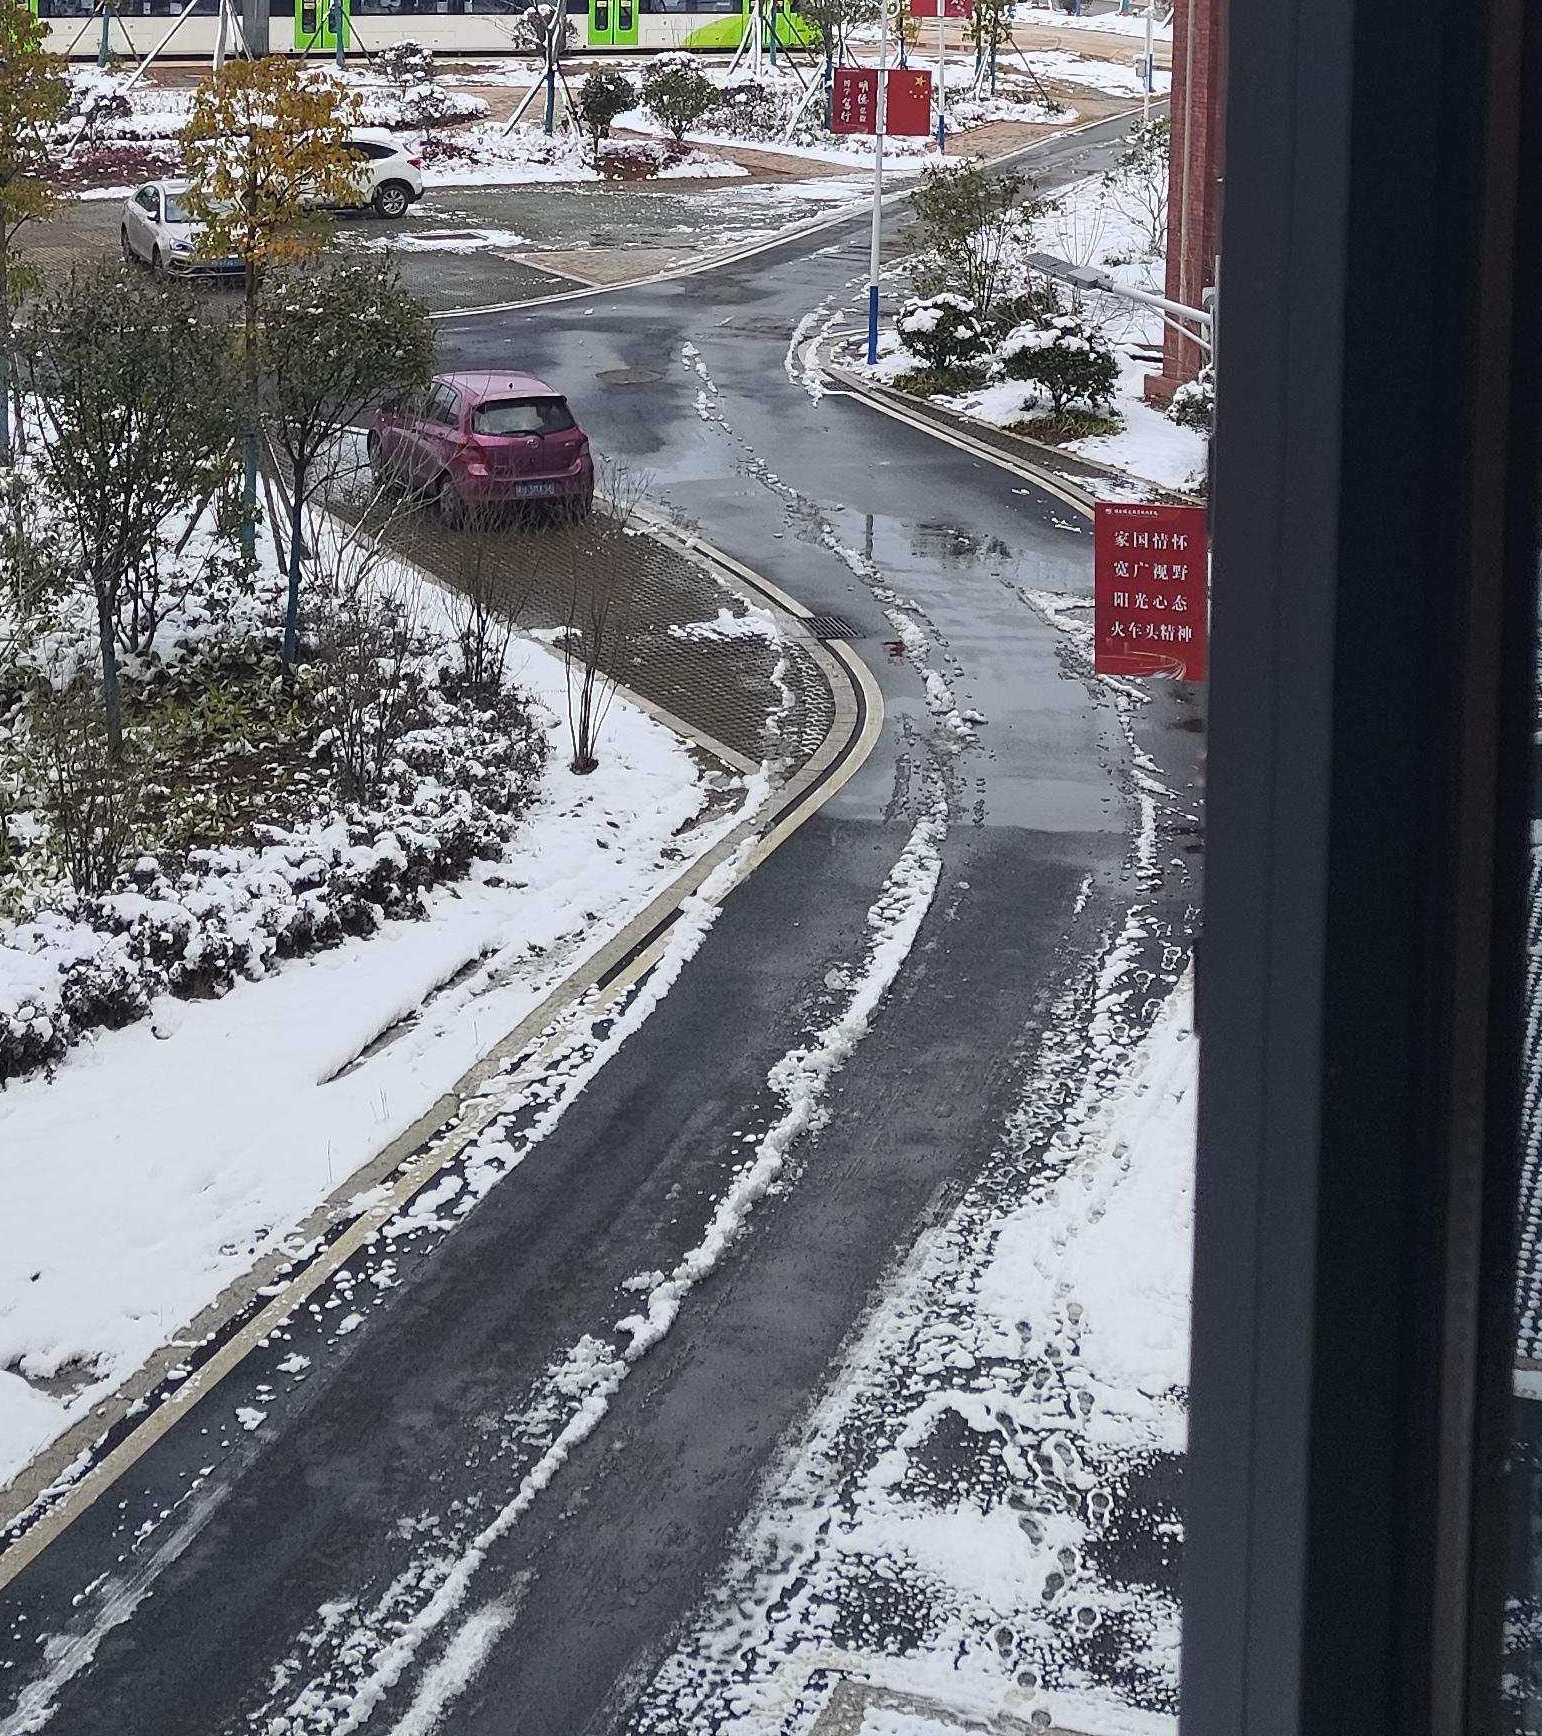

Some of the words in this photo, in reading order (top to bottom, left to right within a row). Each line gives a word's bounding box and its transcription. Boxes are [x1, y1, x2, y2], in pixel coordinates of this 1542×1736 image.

[1114, 530, 1188, 551] 家国情怀
[1113, 561, 1189, 581] 宽广视野
[1113, 592, 1188, 611] 阳光心态
[1111, 621, 1192, 642] 火车头精神
